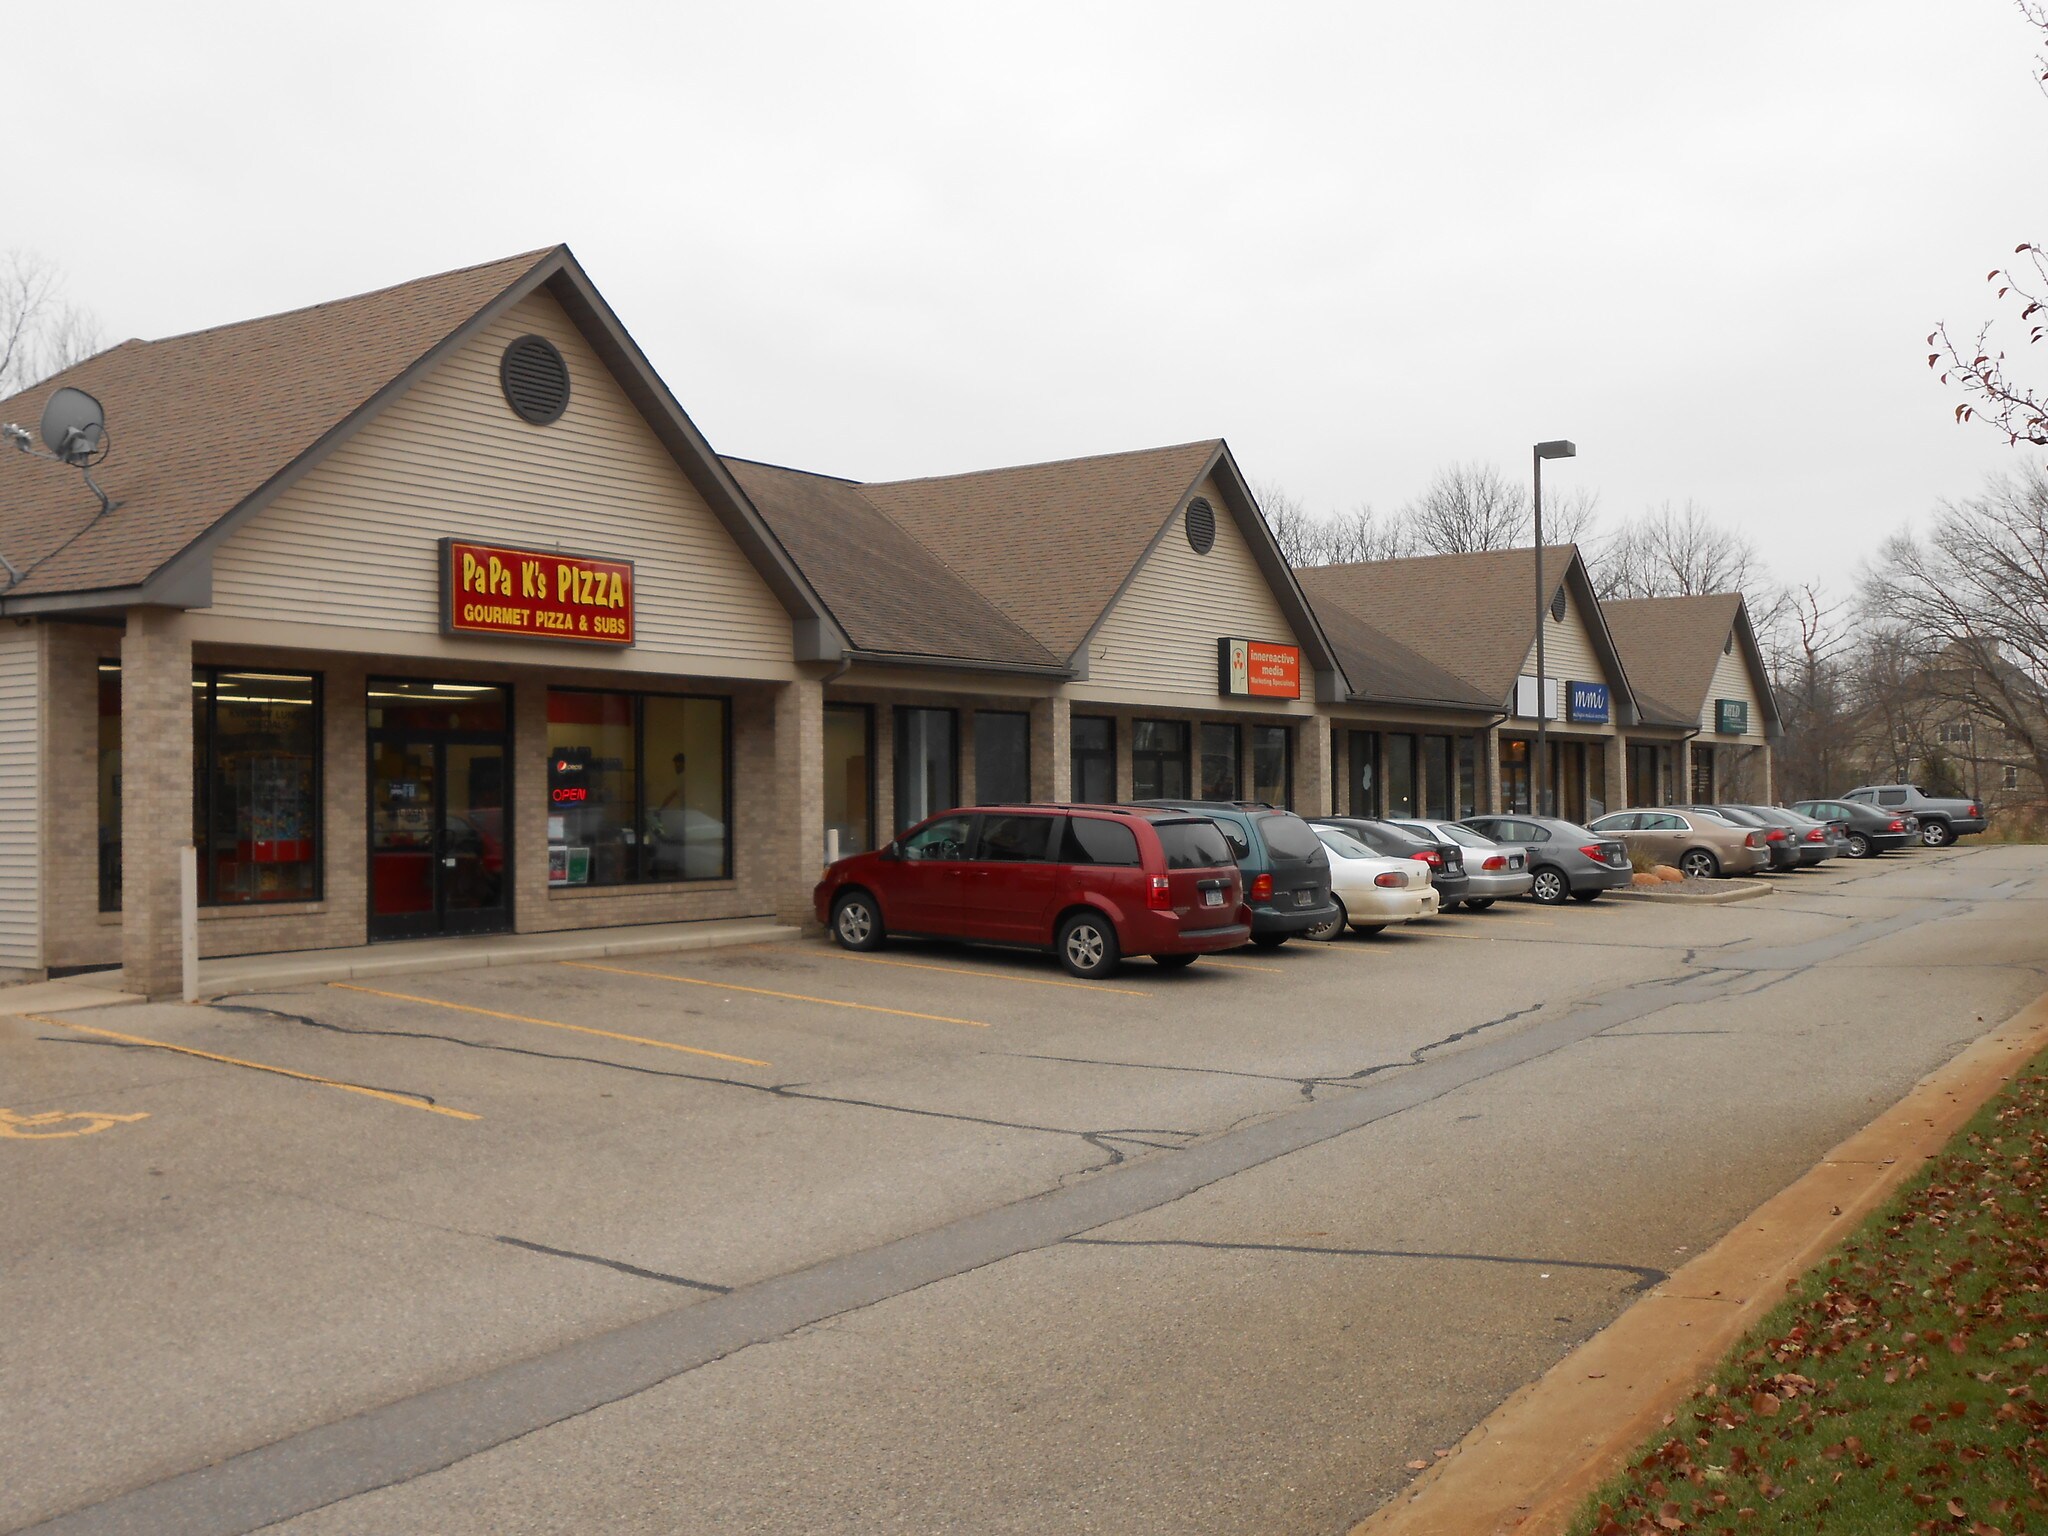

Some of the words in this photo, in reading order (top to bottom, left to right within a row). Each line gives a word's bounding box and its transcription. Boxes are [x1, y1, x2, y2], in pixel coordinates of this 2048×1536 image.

[463, 552, 512, 597] PaPa
[522, 560, 547, 599] K's
[557, 564, 625, 609] PIZZA
[464, 603, 530, 627] GOURMET
[536, 610, 574, 630] PIZZA
[579, 614, 588, 631] &
[594, 617, 626, 635] SUBS
[1250, 649, 1295, 665] innereactive
[1261, 664, 1284, 677] media
[1575, 688, 1605, 709] mmi
[552, 788, 587, 802] OPEN
